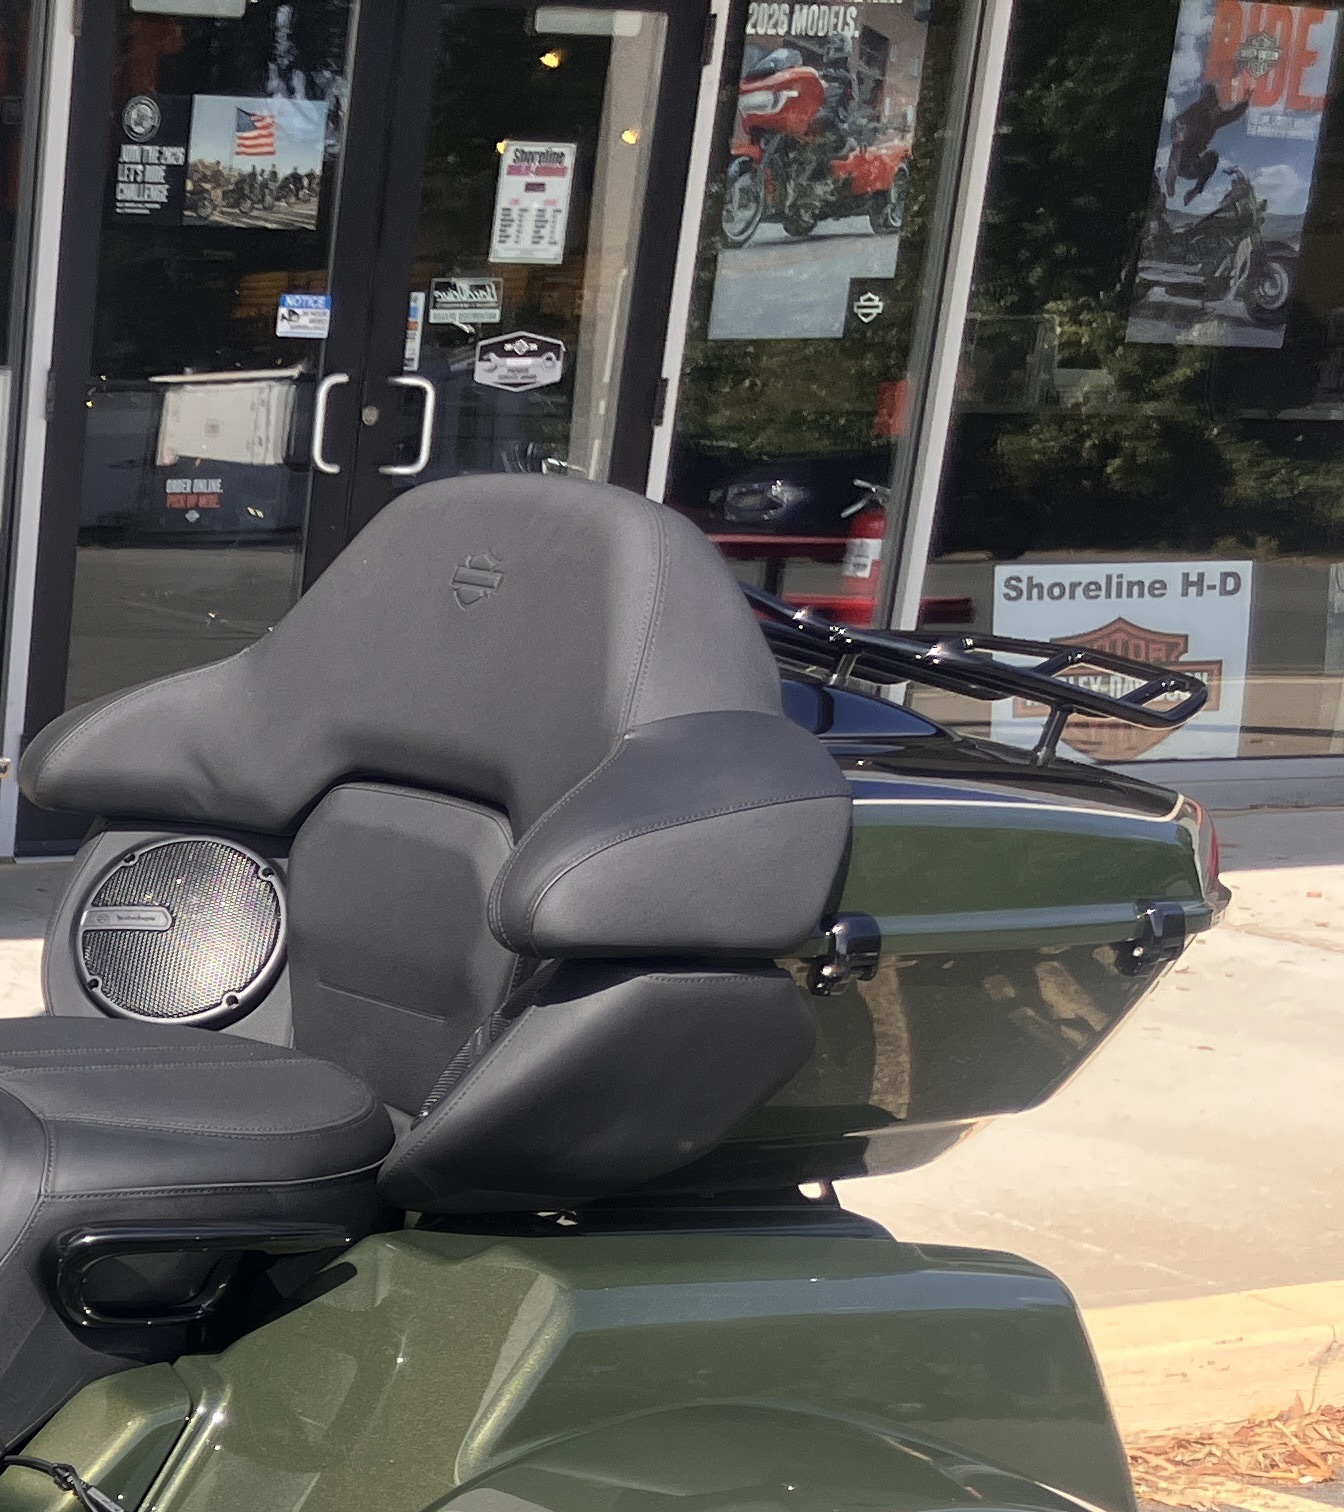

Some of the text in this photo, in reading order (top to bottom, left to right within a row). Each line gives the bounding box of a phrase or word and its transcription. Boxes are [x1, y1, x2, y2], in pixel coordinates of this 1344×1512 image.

[745, 2, 860, 38] 2026 MODELS.
[1204, 0, 1326, 112] RIDE
[287, 294, 326, 308] NOTICE
[1002, 571, 1242, 601] Shoreline H-D
